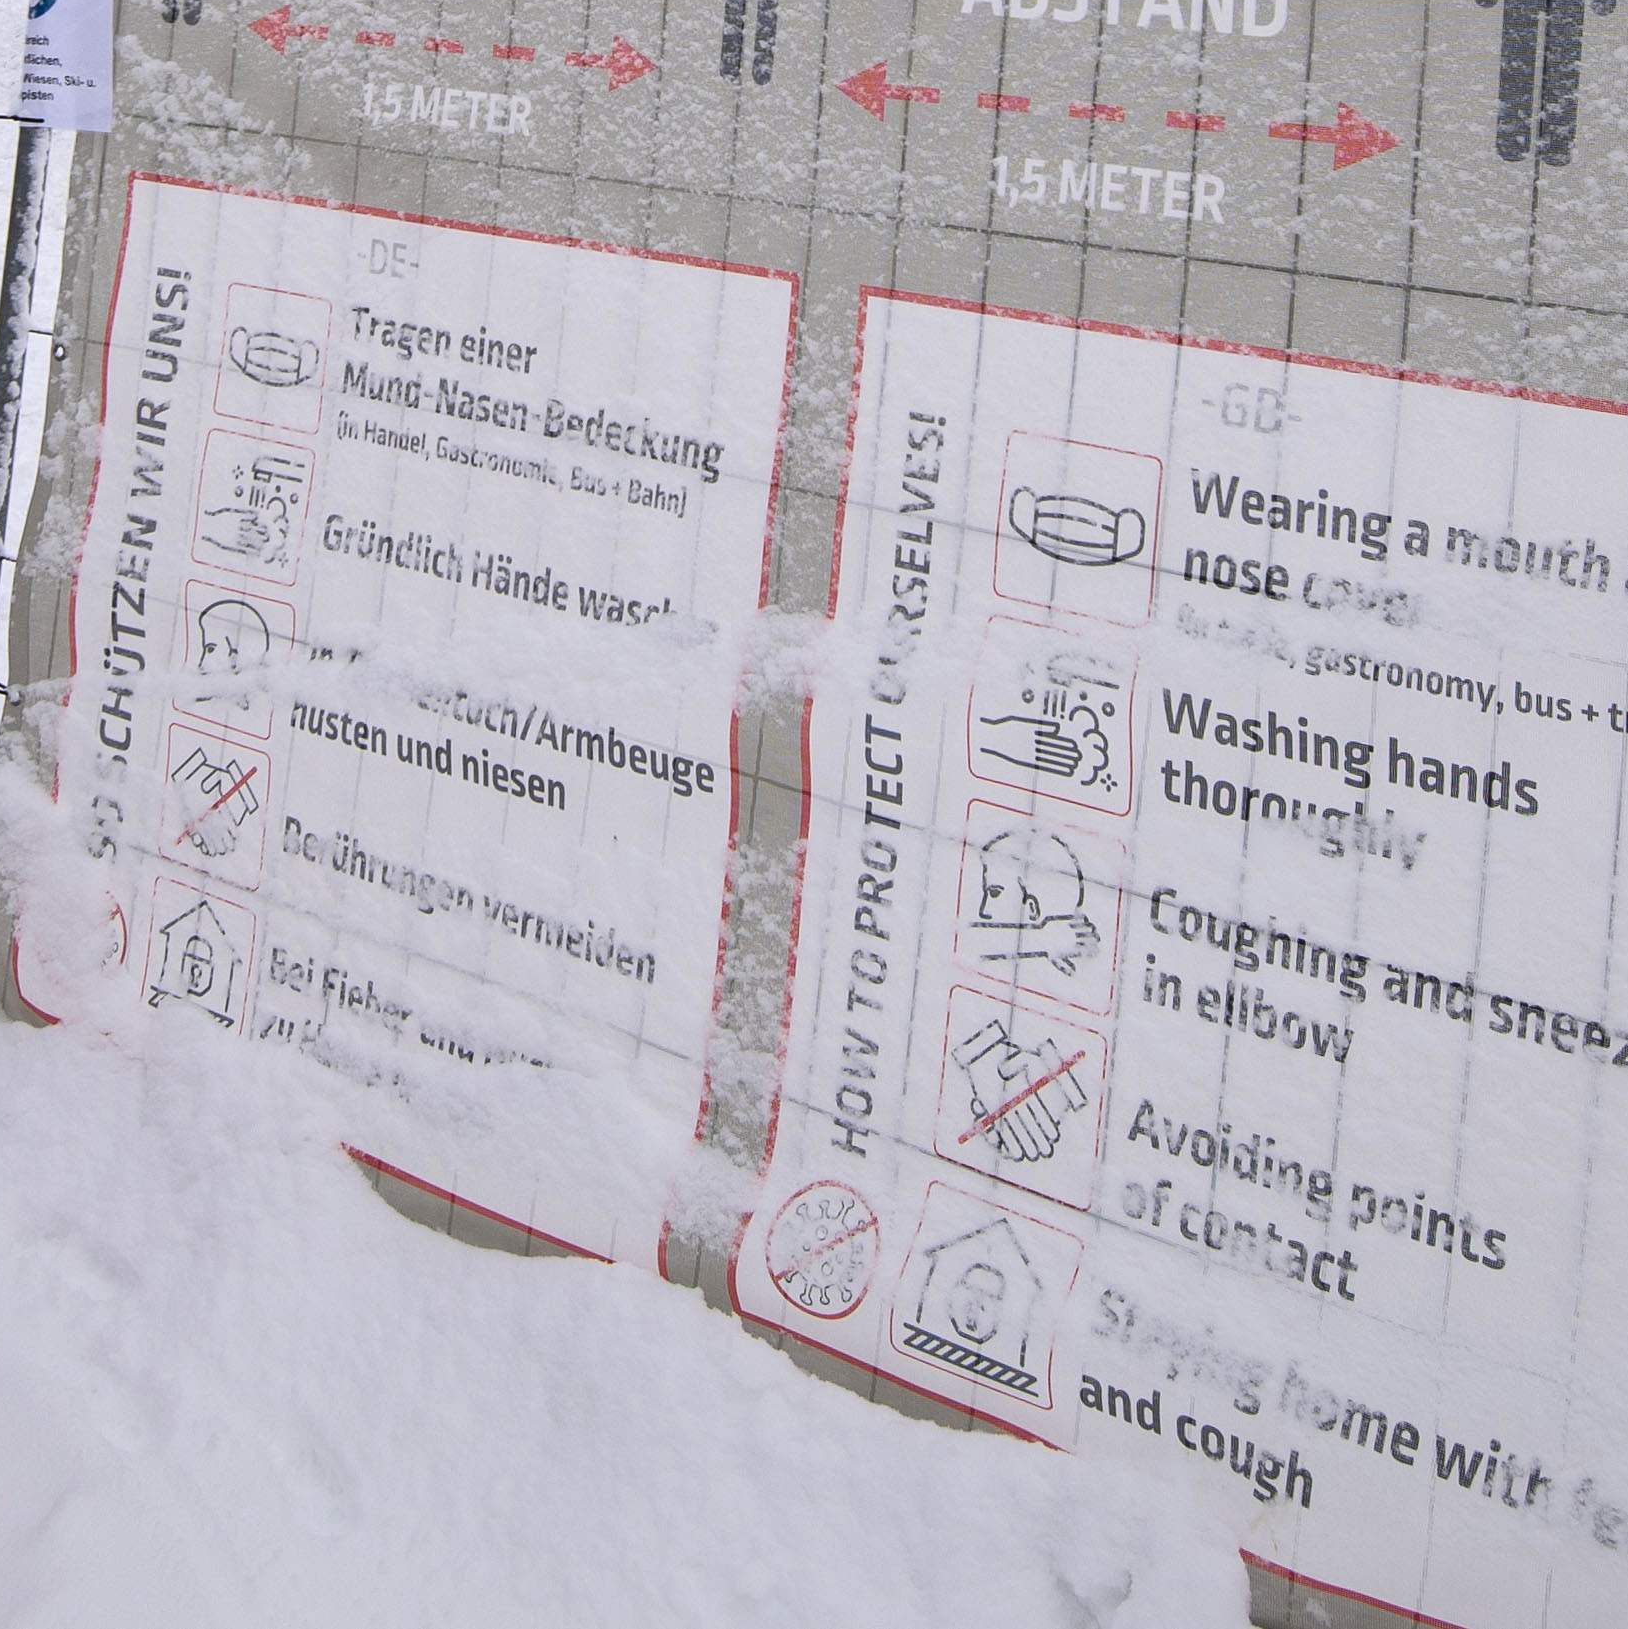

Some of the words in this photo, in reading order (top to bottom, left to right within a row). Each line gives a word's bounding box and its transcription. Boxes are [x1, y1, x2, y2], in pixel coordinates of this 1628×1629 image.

[363, 82, 403, 130] 1,5
[410, 84, 533, 137] METER
[992, 156, 1047, 208] 1,5
[1058, 158, 1226, 225] METER
[356, 239, 420, 278] -DE-
[141, 266, 192, 384] UNS!
[352, 307, 451, 361] Tragen
[460, 326, 538, 374] einer
[130, 395, 171, 498] WIR
[323, 514, 463, 584] Gründlich
[471, 550, 570, 613] Hände
[1183, 544, 1291, 601] nose
[1190, 468, 1392, 562] Wearing
[1403, 517, 1430, 558] a
[1446, 525, 1611, 595] mouth
[1304, 645, 1505, 715] gastronomy,
[1513, 680, 1573, 725] bus
[397, 732, 452, 776] und
[462, 750, 566, 811] niesen
[1162, 686, 1374, 790] Washing
[1387, 737, 1540, 818] hands
[852, 712, 905, 941] PROTECT
[483, 894, 657, 984] vermeiden
[847, 947, 889, 1012] TO
[1142, 953, 1183, 1012] in
[1149, 886, 1370, 1005] Coughing
[1383, 964, 1473, 1024] and
[830, 1026, 880, 1158] HOW
[1126, 1099, 1334, 1223] Avoiding
[1350, 1183, 1508, 1272] points
[1120, 1179, 1174, 1223] of
[1179, 1200, 1360, 1303] contact
[1079, 1373, 1163, 1435] and
[1175, 1413, 1315, 1509] cough
